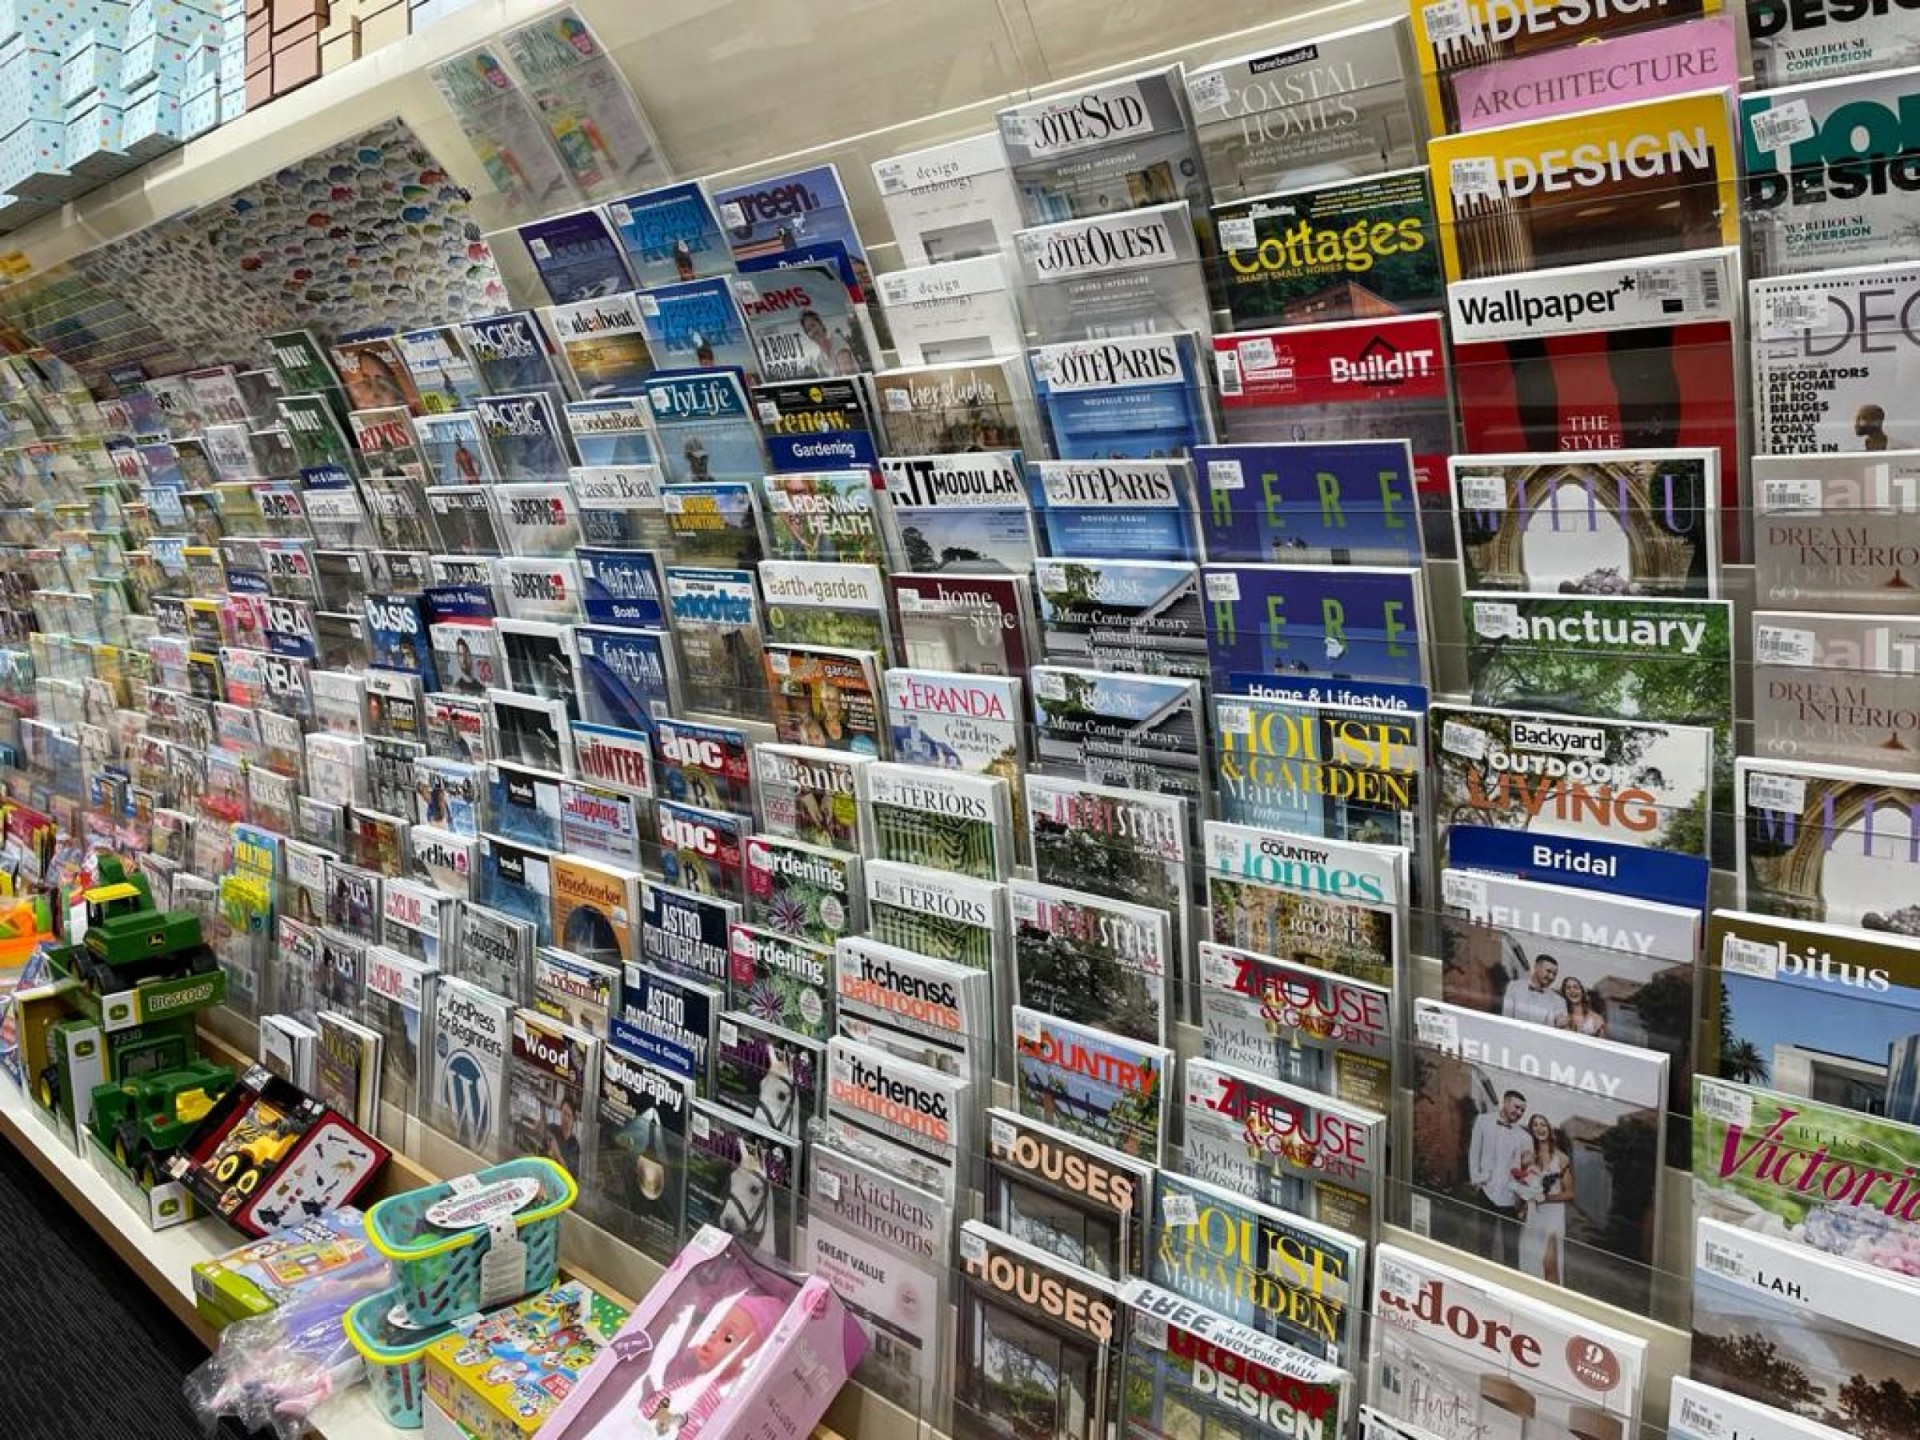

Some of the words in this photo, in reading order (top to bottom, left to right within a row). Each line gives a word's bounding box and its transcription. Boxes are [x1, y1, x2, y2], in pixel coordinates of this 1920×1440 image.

[1786, 38, 1865, 60] WAREHOUSE
[1787, 49, 1872, 71] CONVERSION
[1471, 47, 1719, 118] ARCHITECTURE
[916, 161, 959, 179] design
[1228, 217, 1424, 273] Cottages
[1786, 226, 1871, 244] CONVERSION
[919, 278, 960, 294] design
[1329, 349, 1434, 382] BuildIT
[1769, 367, 1870, 382] DECORATORS
[1770, 382, 1787, 393] AT
[1790, 380, 1836, 391] HOME
[1770, 393, 1786, 403] IN
[1790, 391, 1817, 402] RIO
[1770, 402, 1829, 413] BRUGES
[1771, 413, 1821, 424] MIAMI
[1567, 415, 1609, 431] THE
[1771, 424, 1815, 434] CDMX
[793, 440, 856, 458] Gardening
[1561, 434, 1621, 450] STYLE
[1772, 444, 1793, 454] LET
[1800, 443, 1818, 453] US
[1821, 443, 1838, 453] IN
[1787, 434, 1816, 444] NYC
[932, 469, 1019, 496] MODULAR
[1210, 471, 1406, 528] HERE
[808, 515, 873, 535] HEALTH
[1769, 527, 1868, 546] DREAM
[937, 583, 993, 608] home
[613, 605, 641, 618] Boats
[970, 604, 1017, 634] style
[1092, 609, 1190, 632] Contemporary
[1213, 594, 1408, 658] HERE
[1481, 610, 1706, 654] anctuary
[1249, 684, 1303, 702] Home
[1308, 687, 1320, 702] &
[1327, 689, 1409, 711] Lifestyle
[1769, 681, 1867, 705] DREAM
[1799, 701, 1920, 729] INTERIO
[1085, 719, 1182, 745] Contemporary
[1513, 725, 1603, 751] Backyard
[1488, 752, 1631, 784] OUTDOOR
[1248, 754, 1412, 811] GARDEN
[1467, 766, 1659, 832] LIVING
[1259, 842, 1329, 864] COUNTRY
[1532, 845, 1617, 878] Bridal
[662, 903, 702, 940] ASTRO
[1469, 902, 1572, 940] HELLO
[1581, 920, 1658, 955] MAY
[732, 931, 825, 985] ardening
[1723, 931, 1890, 992] bitus
[646, 987, 685, 1027] ASTRO
[524, 1029, 570, 1069] Wood
[1442, 1038, 1541, 1077] HELLO
[1550, 1060, 1622, 1097] MAY
[840, 1049, 949, 1122] itchens&
[853, 1172, 934, 1231] Kitchens
[816, 1239, 849, 1263] GREAT
[850, 1256, 885, 1284] VALUE
[1184, 1250, 1340, 1344] GARDEN
[1752, 1271, 1810, 1302] LAH.
[1377, 1308, 1419, 1334] HOME
[1192, 1359, 1323, 1440] DESIGN
